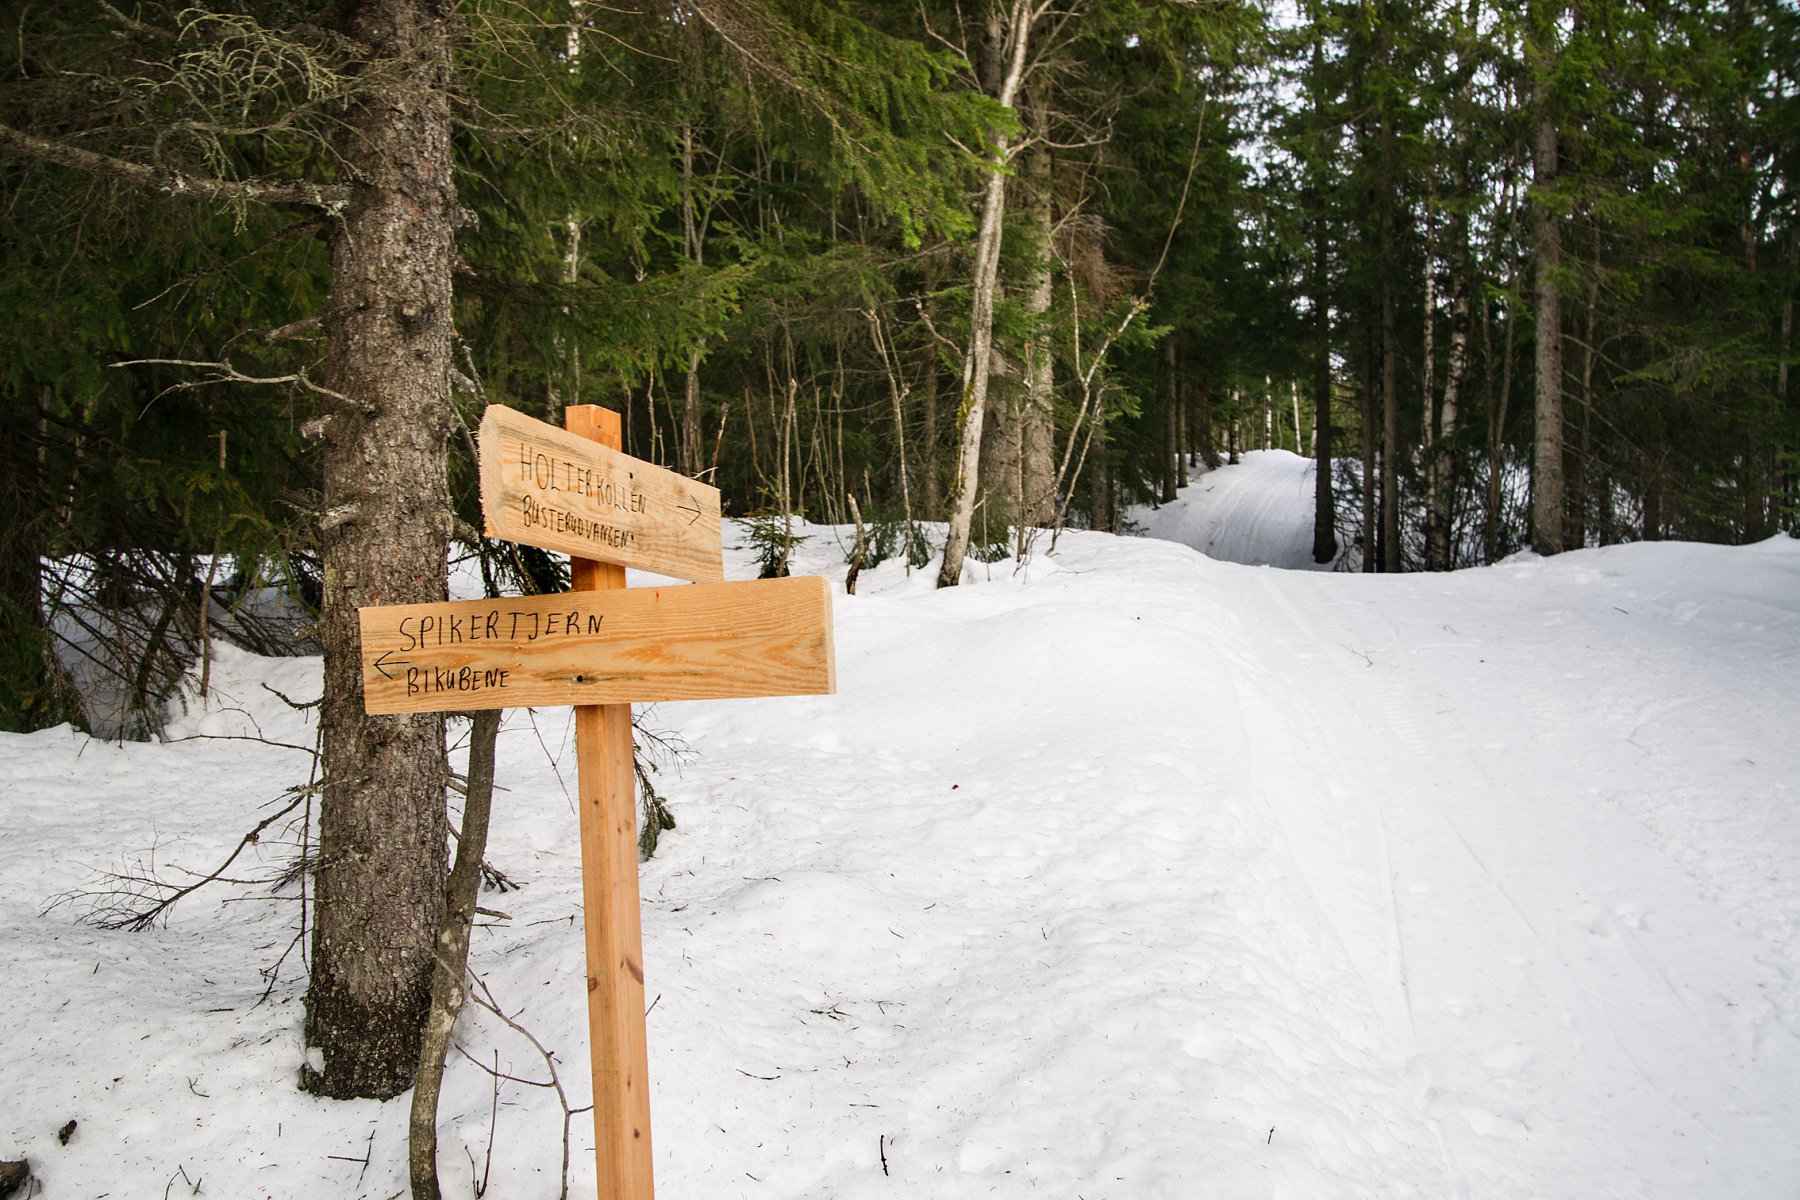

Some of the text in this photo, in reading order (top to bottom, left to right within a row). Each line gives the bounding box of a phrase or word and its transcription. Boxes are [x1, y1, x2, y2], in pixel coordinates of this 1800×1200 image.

[520, 442, 646, 515] HOLTERKOLLEN
[522, 494, 629, 548] BUSTERUDVANGEN
[399, 610, 604, 652] SPIKERTJERN
[407, 666, 510, 697] BIKUBENE
